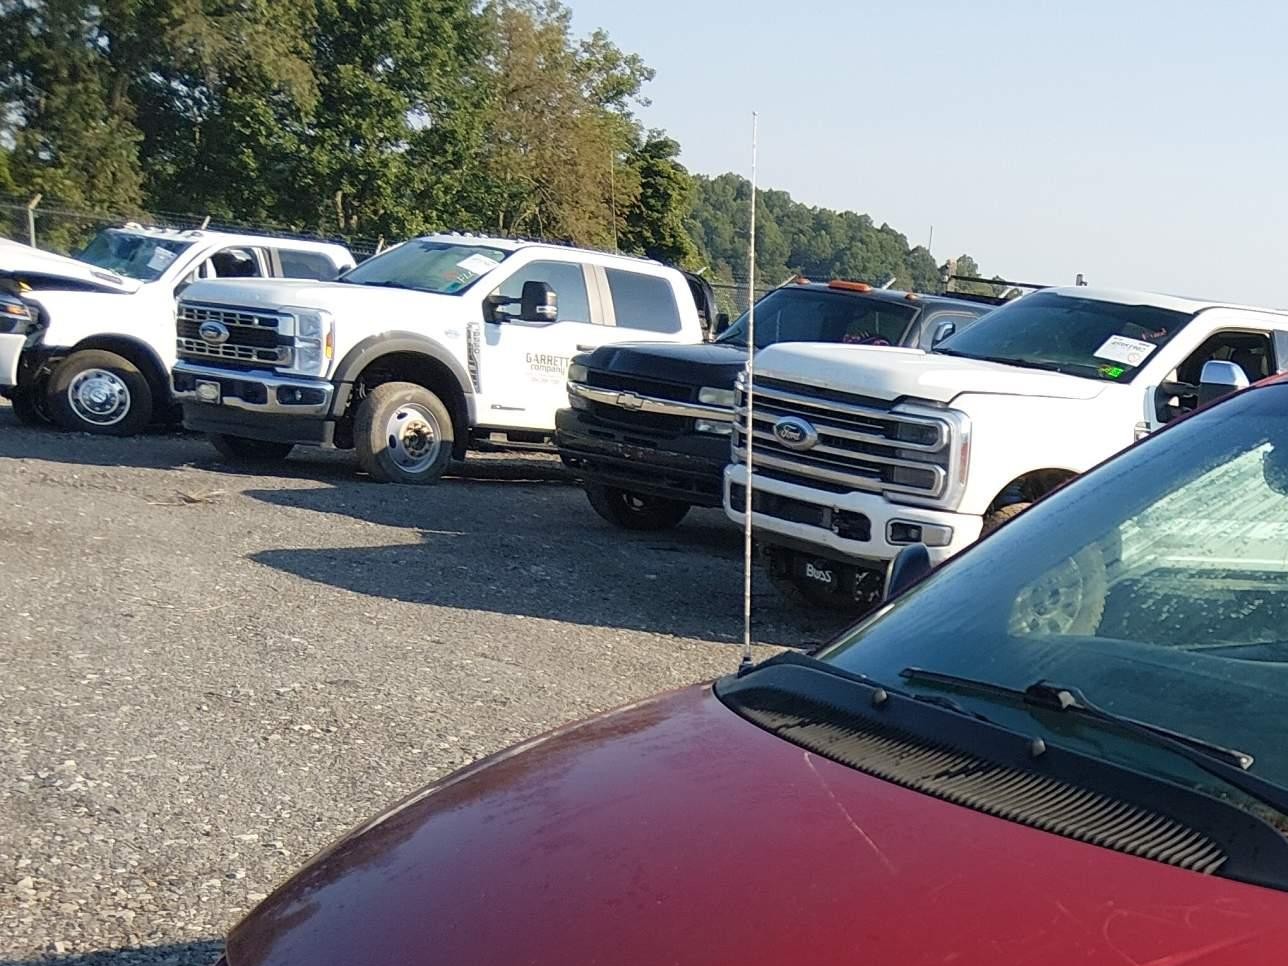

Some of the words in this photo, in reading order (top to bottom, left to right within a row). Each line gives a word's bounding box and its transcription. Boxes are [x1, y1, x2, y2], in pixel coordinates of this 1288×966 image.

[526, 352, 570, 369] GARRETT
[530, 363, 565, 377] company
[780, 424, 801, 441] Ford
